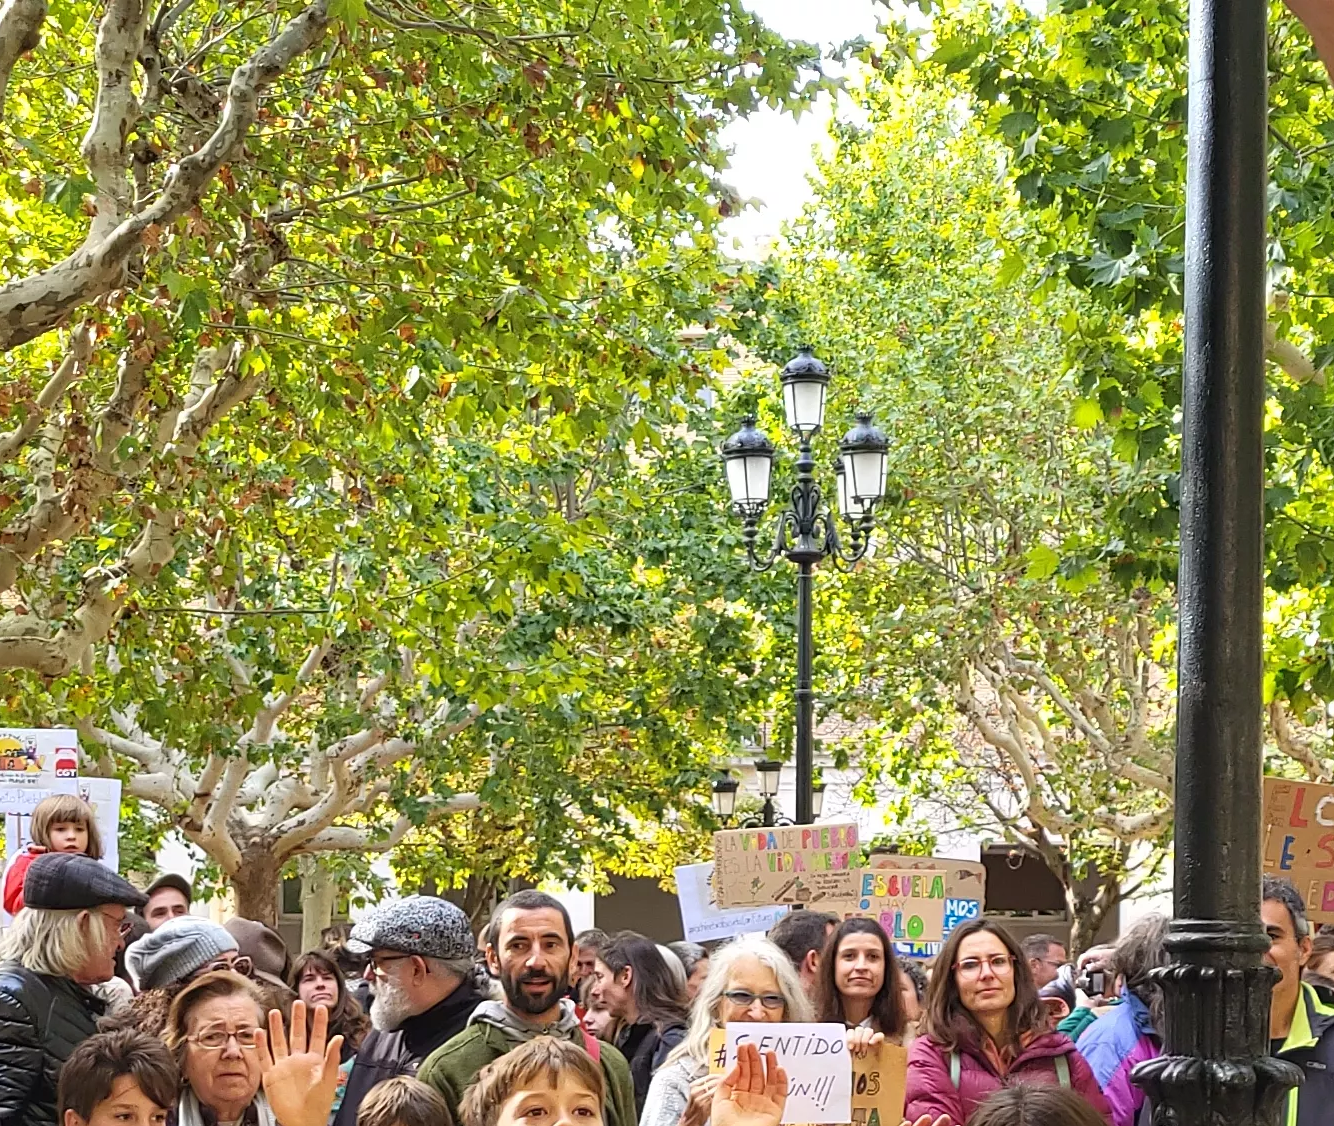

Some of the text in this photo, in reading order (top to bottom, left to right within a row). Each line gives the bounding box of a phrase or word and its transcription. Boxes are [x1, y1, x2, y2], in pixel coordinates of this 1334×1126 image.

[782, 831, 795, 849] DE
[802, 826, 857, 850] PUEBLO
[747, 855, 762, 873] LA
[861, 873, 945, 899] ESCUELA
[879, 898, 908, 910] HAY
